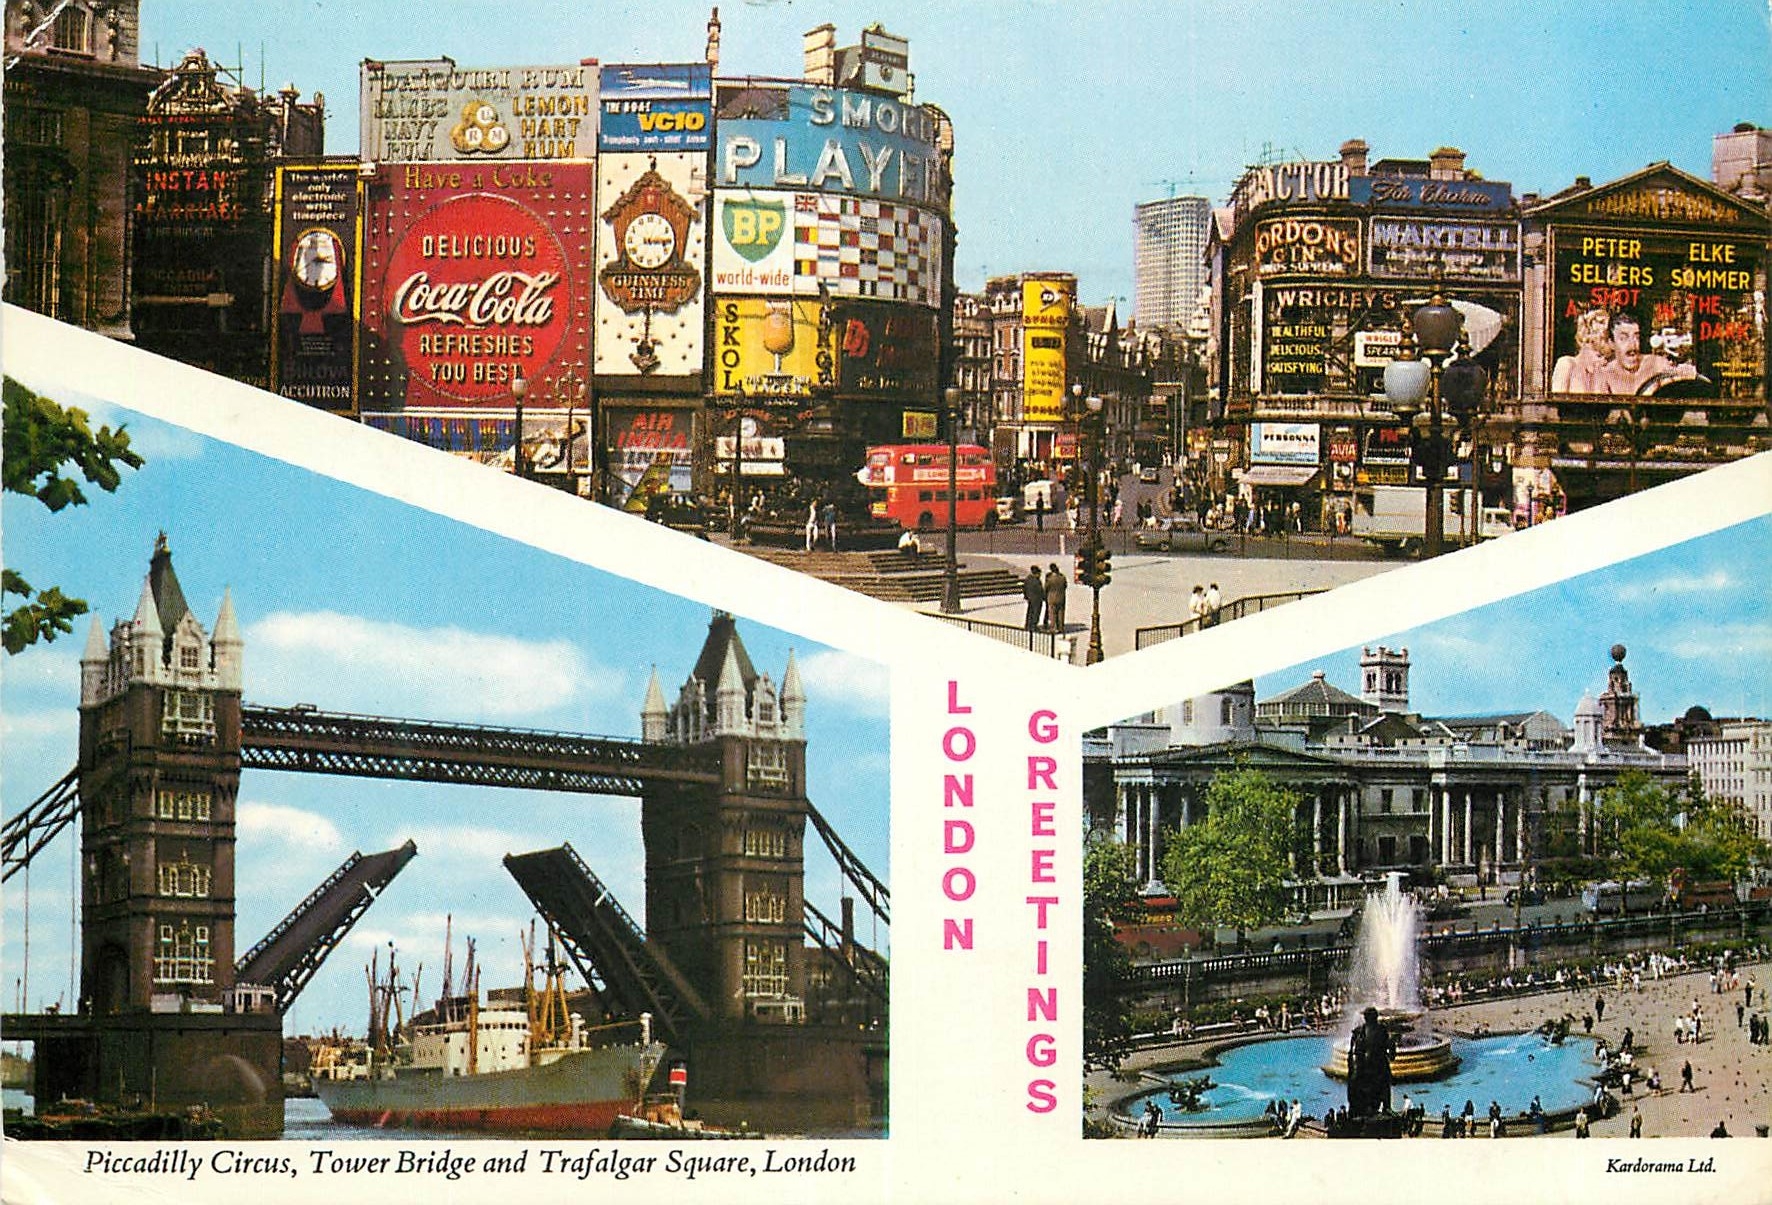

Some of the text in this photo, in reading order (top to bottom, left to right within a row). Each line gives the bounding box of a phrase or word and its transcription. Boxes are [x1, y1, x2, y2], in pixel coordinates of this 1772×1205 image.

[520, 69, 585, 89] RUM
[512, 96, 588, 116] LEMON
[521, 118, 581, 138] HART
[638, 112, 705, 131] VC10
[524, 140, 575, 158] RUM
[405, 164, 552, 188] Have a Coke
[731, 208, 781, 245] BP
[1373, 223, 1518, 249] MARTELL
[423, 235, 537, 258] DELICIOUS
[1582, 237, 1641, 259] PETER
[1689, 242, 1736, 263] ELKE
[612, 275, 687, 288] GUINNESS
[717, 268, 790, 286] world-wide
[1570, 263, 1653, 286] SELLERS
[1671, 268, 1750, 289] SOMMER
[393, 271, 560, 329] Coca-Cola
[631, 287, 666, 300] TIME
[1591, 287, 1641, 306] SHOT
[1565, 299, 1578, 317] A
[1687, 294, 1721, 315] THE
[1700, 322, 1750, 341] DARK
[420, 334, 535, 356] REFRESHES
[721, 303, 741, 391] SKOL
[430, 363, 520, 383] YOU BEST
[280, 383, 350, 398] ACCUTRON
[632, 412, 674, 430] AIR
[617, 431, 688, 448] INDIA
[1263, 434, 1316, 442] PERSONNA
[1331, 444, 1356, 455] AVIA
